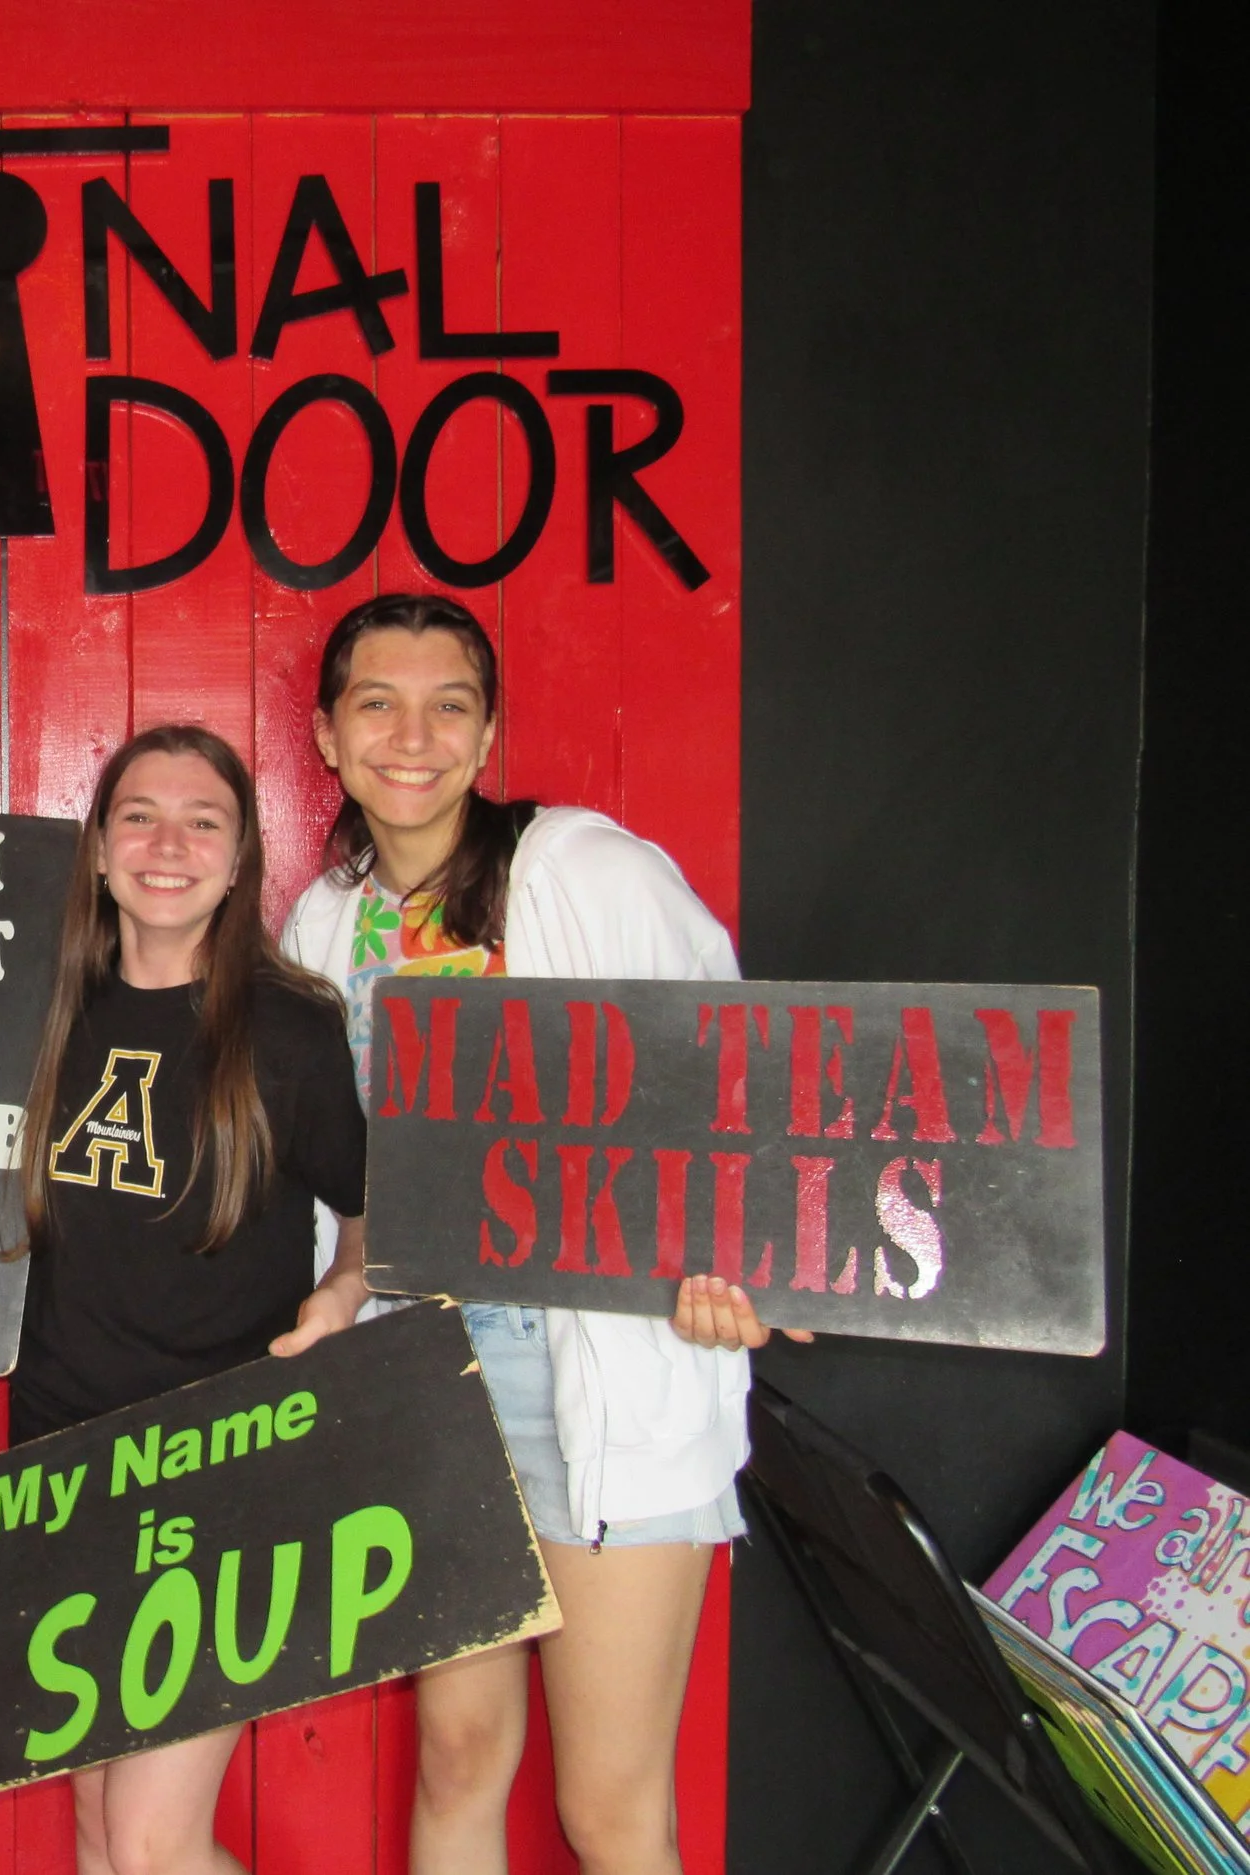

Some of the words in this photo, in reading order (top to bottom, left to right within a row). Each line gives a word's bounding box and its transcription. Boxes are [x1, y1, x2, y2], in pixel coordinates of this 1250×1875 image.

[83, 369, 711, 596] DOOR
[86, 1120, 142, 1143] Mountaineers
[378, 996, 636, 1126] MAD
[696, 1003, 1077, 1149] TEAM
[479, 1136, 943, 1299] SKILLS
[110, 1390, 318, 1498] Name
[1069, 1447, 1166, 1531] We
[134, 1509, 196, 1574] is
[23, 1504, 414, 1762] SOUP
